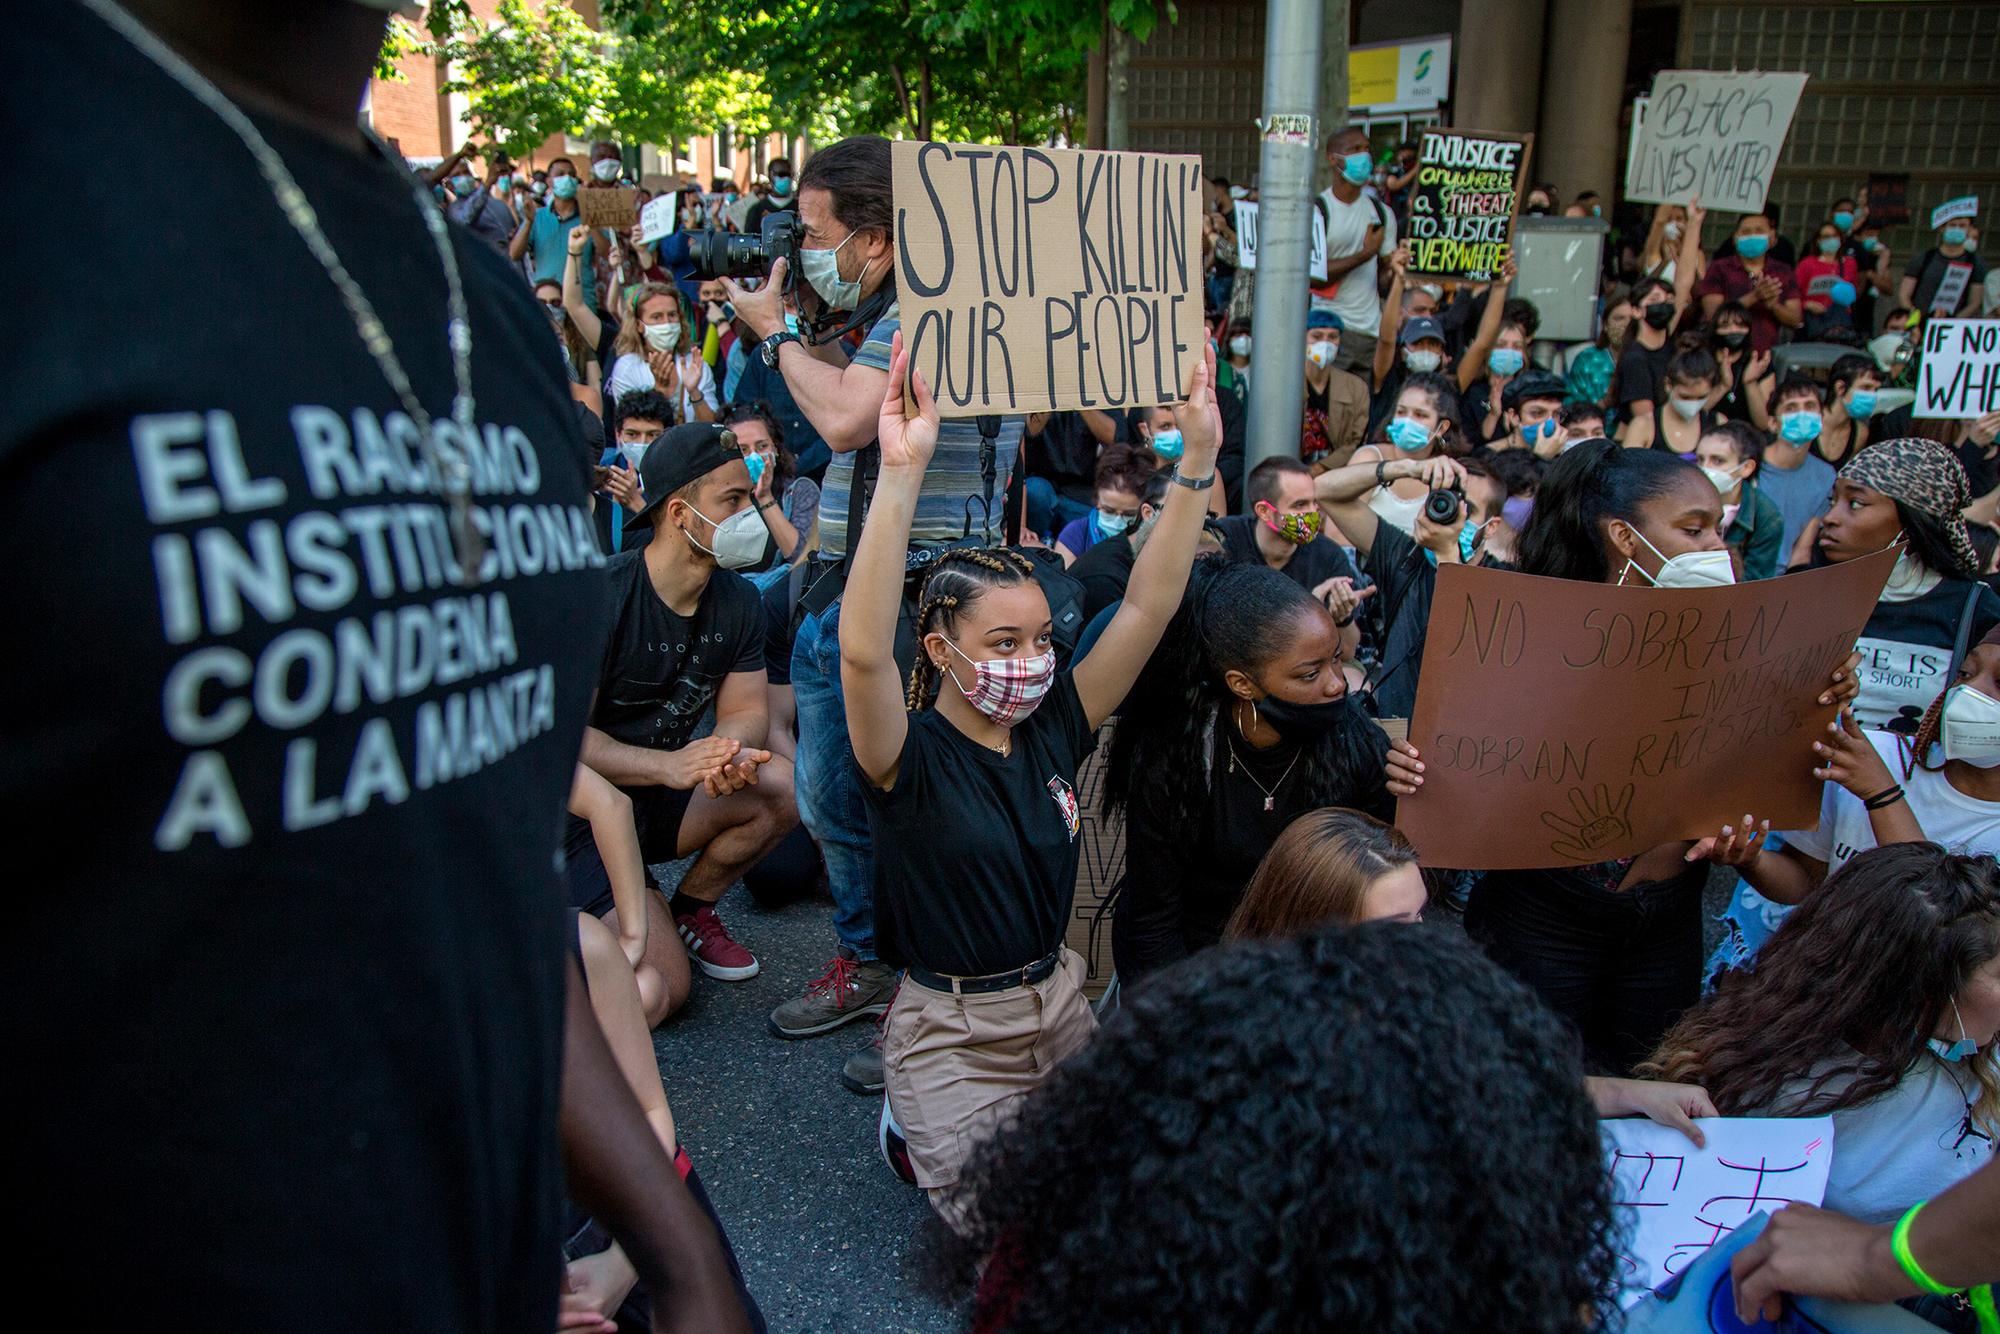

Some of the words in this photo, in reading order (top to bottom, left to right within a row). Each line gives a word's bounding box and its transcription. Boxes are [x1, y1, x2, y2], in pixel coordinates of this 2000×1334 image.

[1655, 82, 1773, 140] BLACK
[1420, 133, 1522, 172] INJUSTICE
[1635, 143, 1701, 199] LIVES
[1700, 140, 1771, 203] MATER
[899, 142, 1059, 297] STOP
[1076, 153, 1200, 295] KILLIN'
[1410, 216, 1438, 239] TO
[1438, 216, 1509, 243] JUSTICE
[1413, 195, 1434, 214] a
[1449, 192, 1511, 215] THREAT
[1407, 238, 1511, 273] EVERYWHERE
[909, 301, 1016, 408] OUR
[1045, 291, 1190, 409] PEOPLE
[1926, 325, 1954, 353] IF
[1961, 325, 2000, 353] NO
[130, 409, 288, 525] EL
[290, 404, 541, 499] RACISMO
[1449, 592, 1526, 668] NO
[1561, 601, 1788, 673] SOBRAN
[163, 592, 518, 746] CONDENA
[1870, 670, 1923, 689] SHORT
[1909, 653, 1937, 676] IS
[154, 750, 254, 852] A
[282, 717, 411, 832] LA
[415, 664, 556, 790] MANTA
[1433, 734, 1598, 784] SOBRAN
